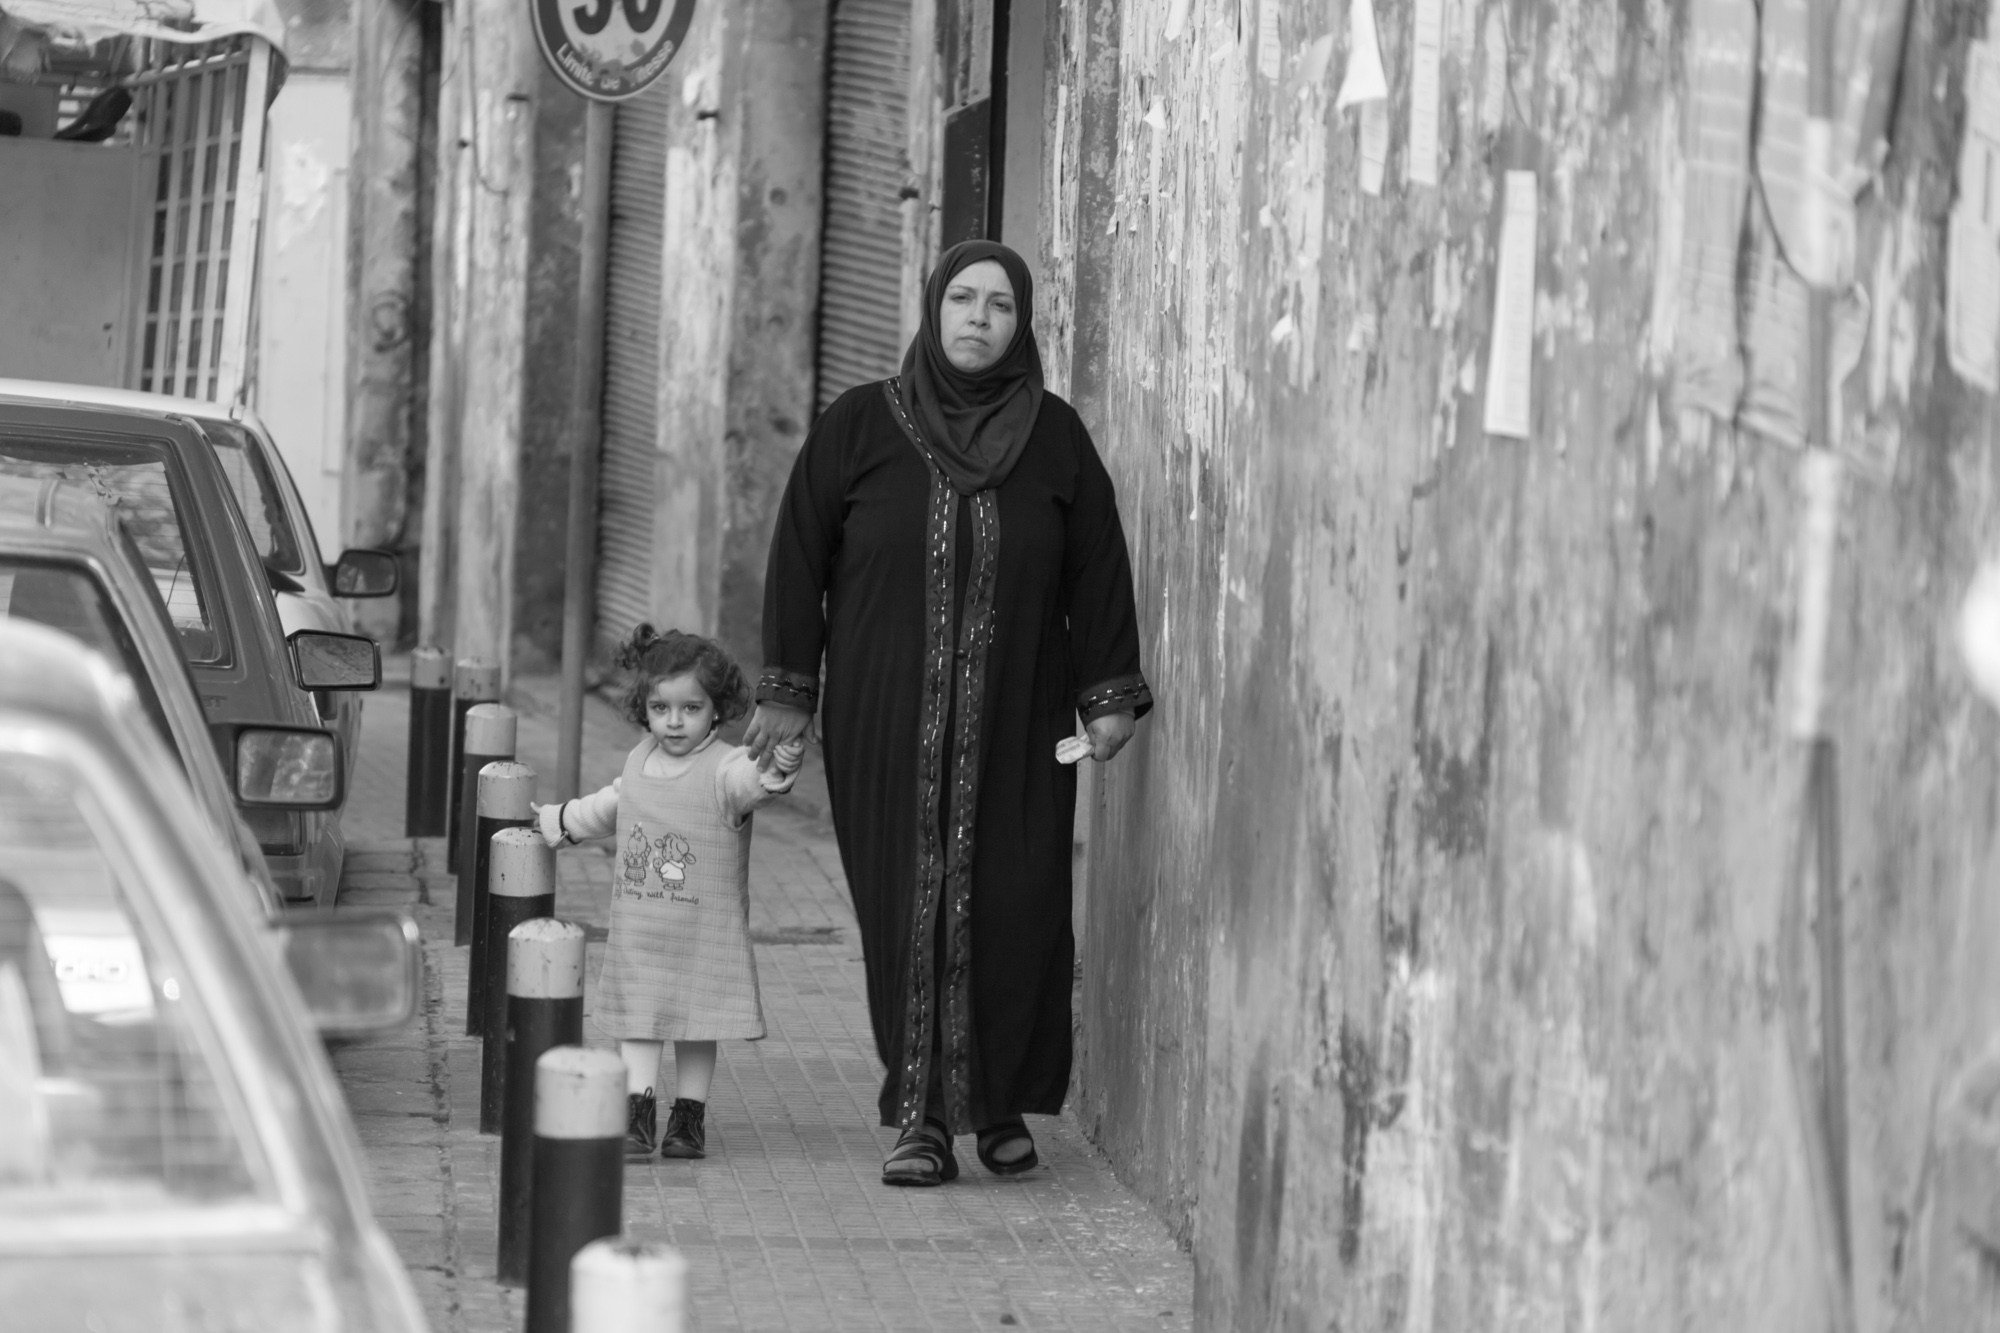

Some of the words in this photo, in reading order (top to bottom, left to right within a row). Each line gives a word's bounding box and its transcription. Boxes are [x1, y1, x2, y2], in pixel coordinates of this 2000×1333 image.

[556, 42, 595, 87] Limite
[646, 890, 664, 900] with
[670, 891, 699, 905] friends
